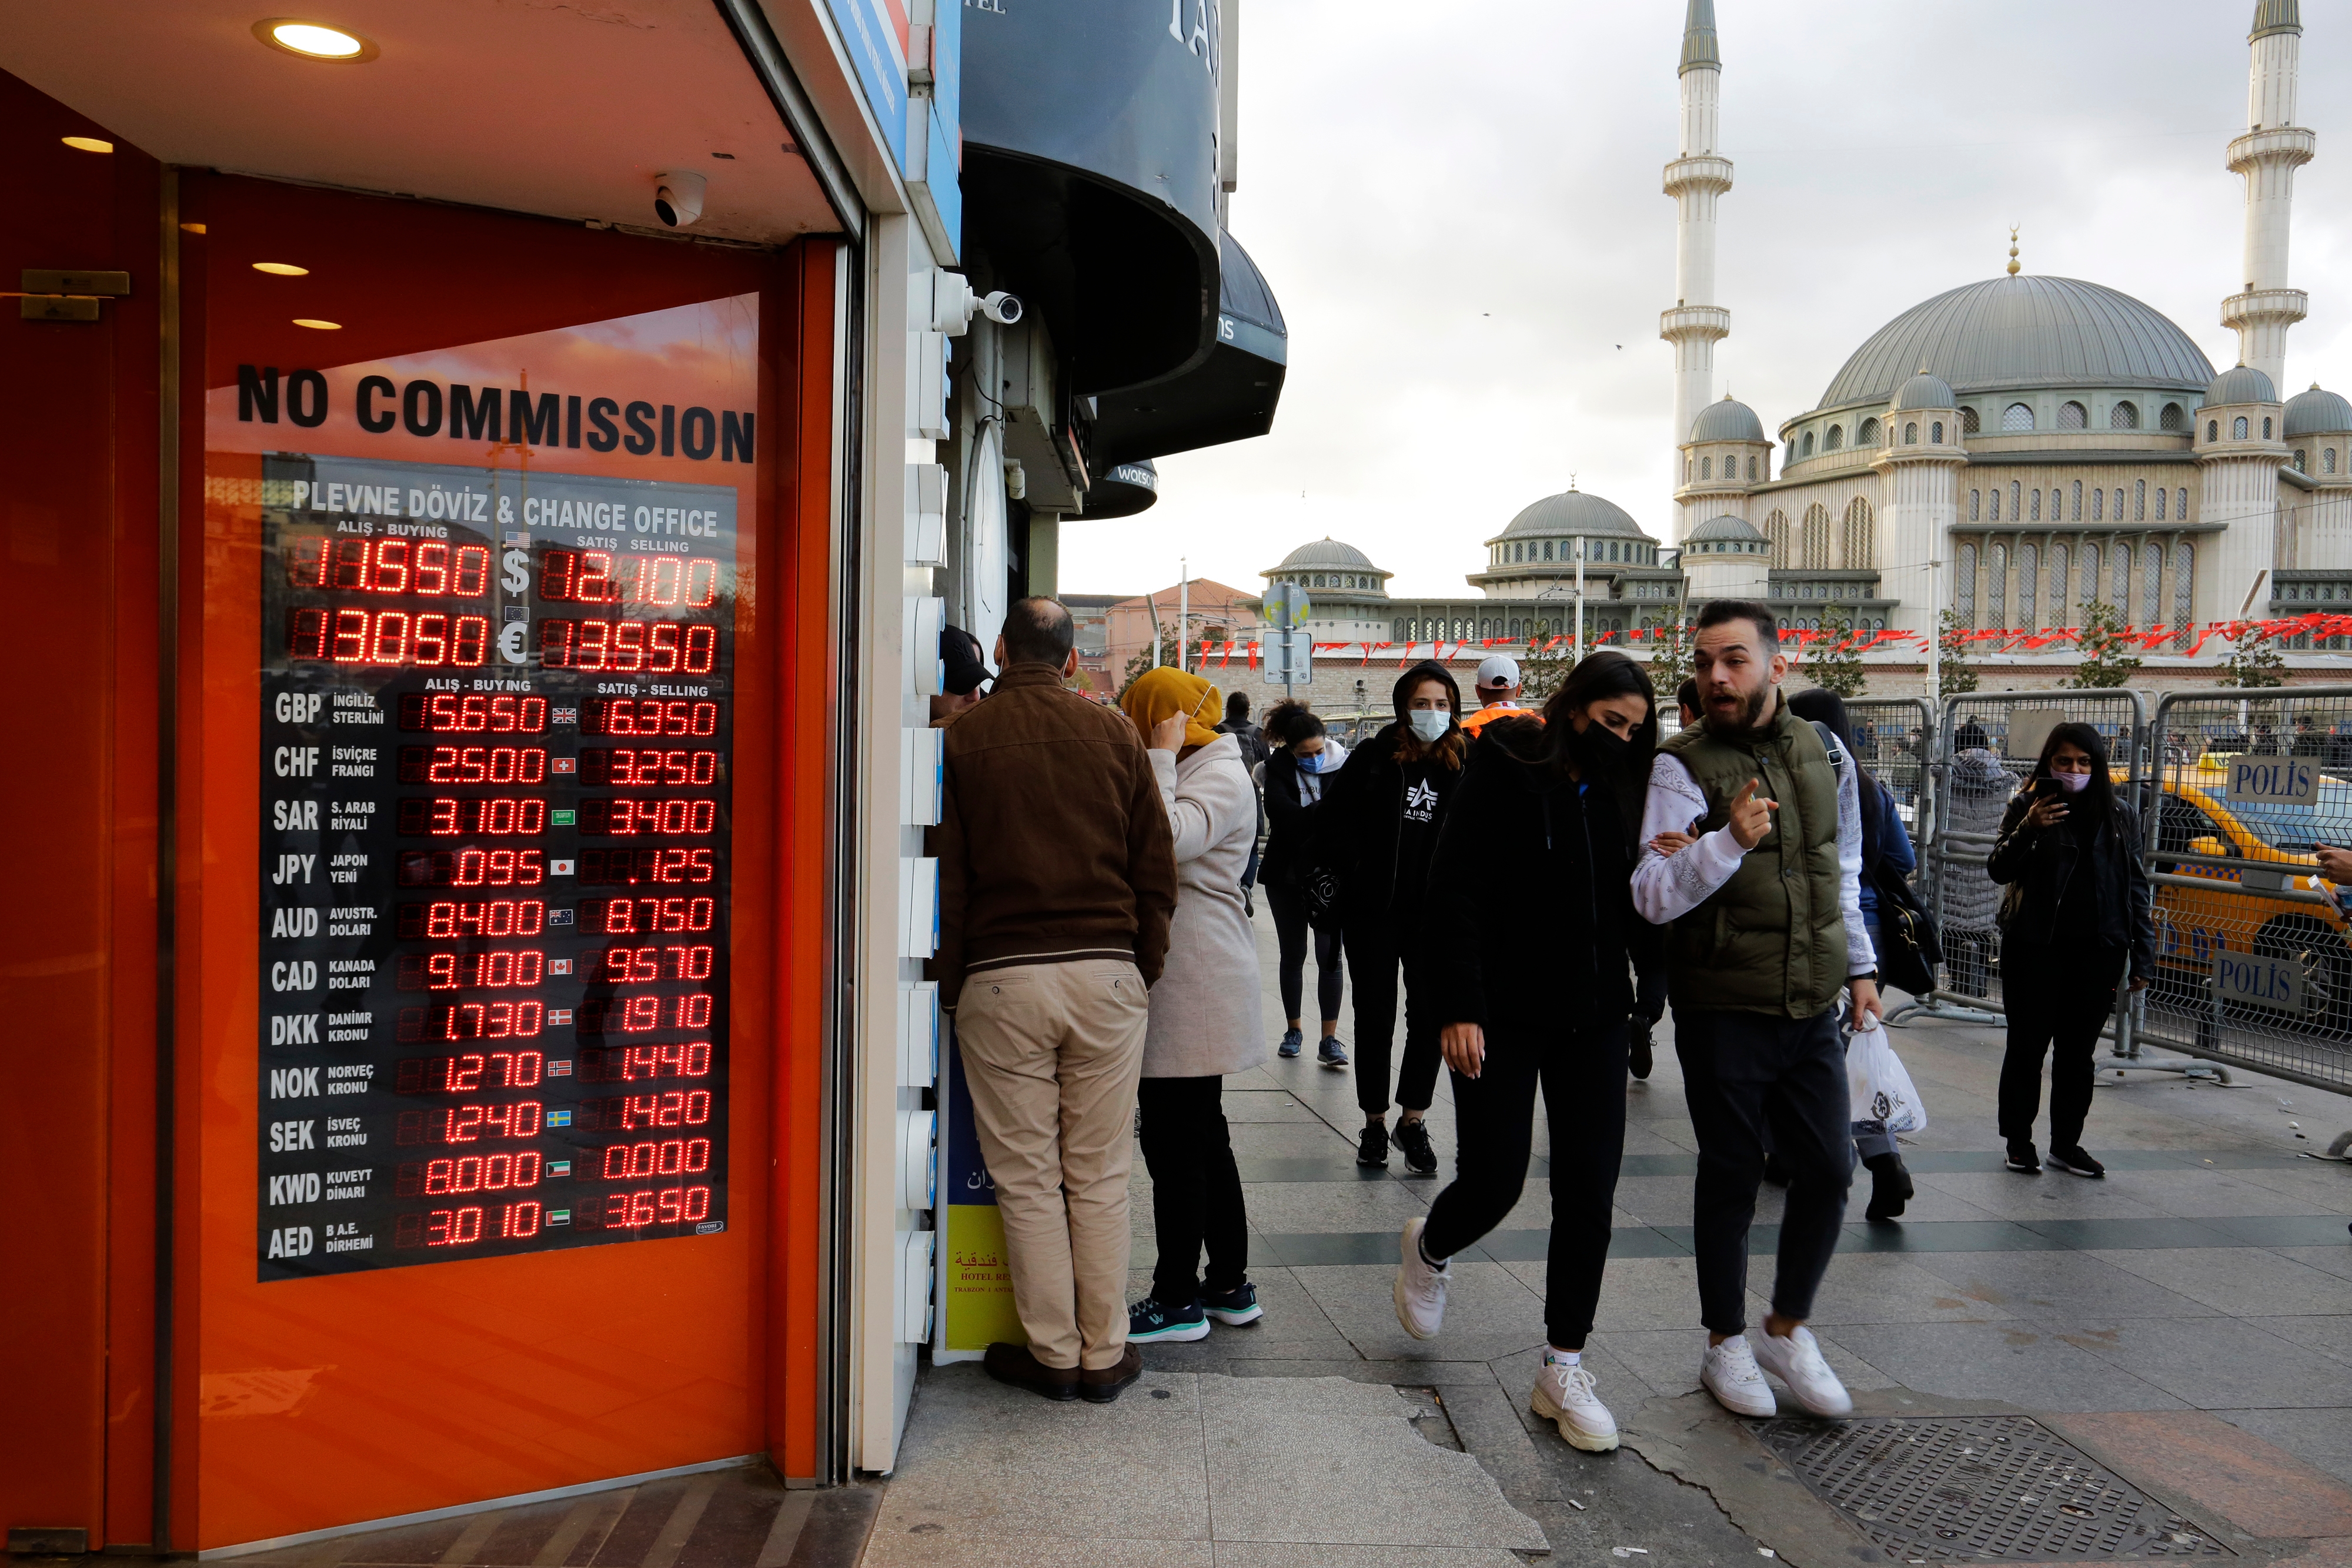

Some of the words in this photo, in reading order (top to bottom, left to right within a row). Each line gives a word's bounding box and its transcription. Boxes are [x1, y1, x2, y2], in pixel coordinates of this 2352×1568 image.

[238, 364, 328, 428] NO
[356, 375, 755, 464] COMMISSION
[293, 480, 400, 516] PLEVNE
[409, 484, 488, 522] DÖVİZ
[497, 496, 514, 524] &
[524, 498, 626, 531] CHANGE
[634, 506, 717, 538] OFFICE
[337, 521, 373, 536] ALIŞ
[387, 524, 448, 538] BUYING
[577, 536, 618, 551] SATIŞ
[630, 539, 689, 553] SELLING
[501, 548, 529, 597] $
[497, 622, 527, 664] €
[425, 678, 460, 693] ALIŞ
[473, 680, 531, 692] BUYING
[597, 682, 637, 697] SATIŞ
[650, 685, 709, 697] SELLING
[275, 692, 321, 723] GBP
[333, 692, 375, 707] İNGİLİZ
[333, 710, 384, 724] STERLİNİ
[275, 746, 319, 777] CHF
[332, 745, 377, 763] İSVİÇRE
[332, 765, 374, 777] FRANGI
[2234, 761, 2310, 797] POLİS
[273, 800, 319, 831] SAR
[331, 802, 342, 813] S.
[345, 802, 376, 813] ARAB
[331, 816, 368, 830] RİYALİ
[330, 854, 368, 867] JAPON
[272, 854, 316, 885] JPY
[330, 868, 357, 883] YENİ
[329, 907, 377, 920] AVUSTR.
[272, 907, 318, 938] AUD
[329, 924, 370, 936] DOLARI
[329, 959, 375, 972] KANADA
[272, 961, 317, 992] CAD
[329, 976, 370, 989] DOLARI
[2218, 962, 2291, 1001] POLİS
[328, 1010, 372, 1025] DANİMR
[272, 1014, 319, 1045] DKK
[328, 1028, 368, 1042] KRONU
[328, 1064, 373, 1078] NORVEÇ
[270, 1067, 319, 1099] NOK
[328, 1081, 368, 1095] KRONU
[327, 1116, 360, 1132] İSVEÇ
[270, 1120, 315, 1152] SEK
[327, 1134, 367, 1148] KRONU
[326, 1169, 372, 1184] KUVEYT
[269, 1173, 320, 1205] KWD
[326, 1186, 365, 1201] DİNARI
[268, 1226, 313, 1259] AED
[326, 1235, 373, 1253] DİRHEMİ
